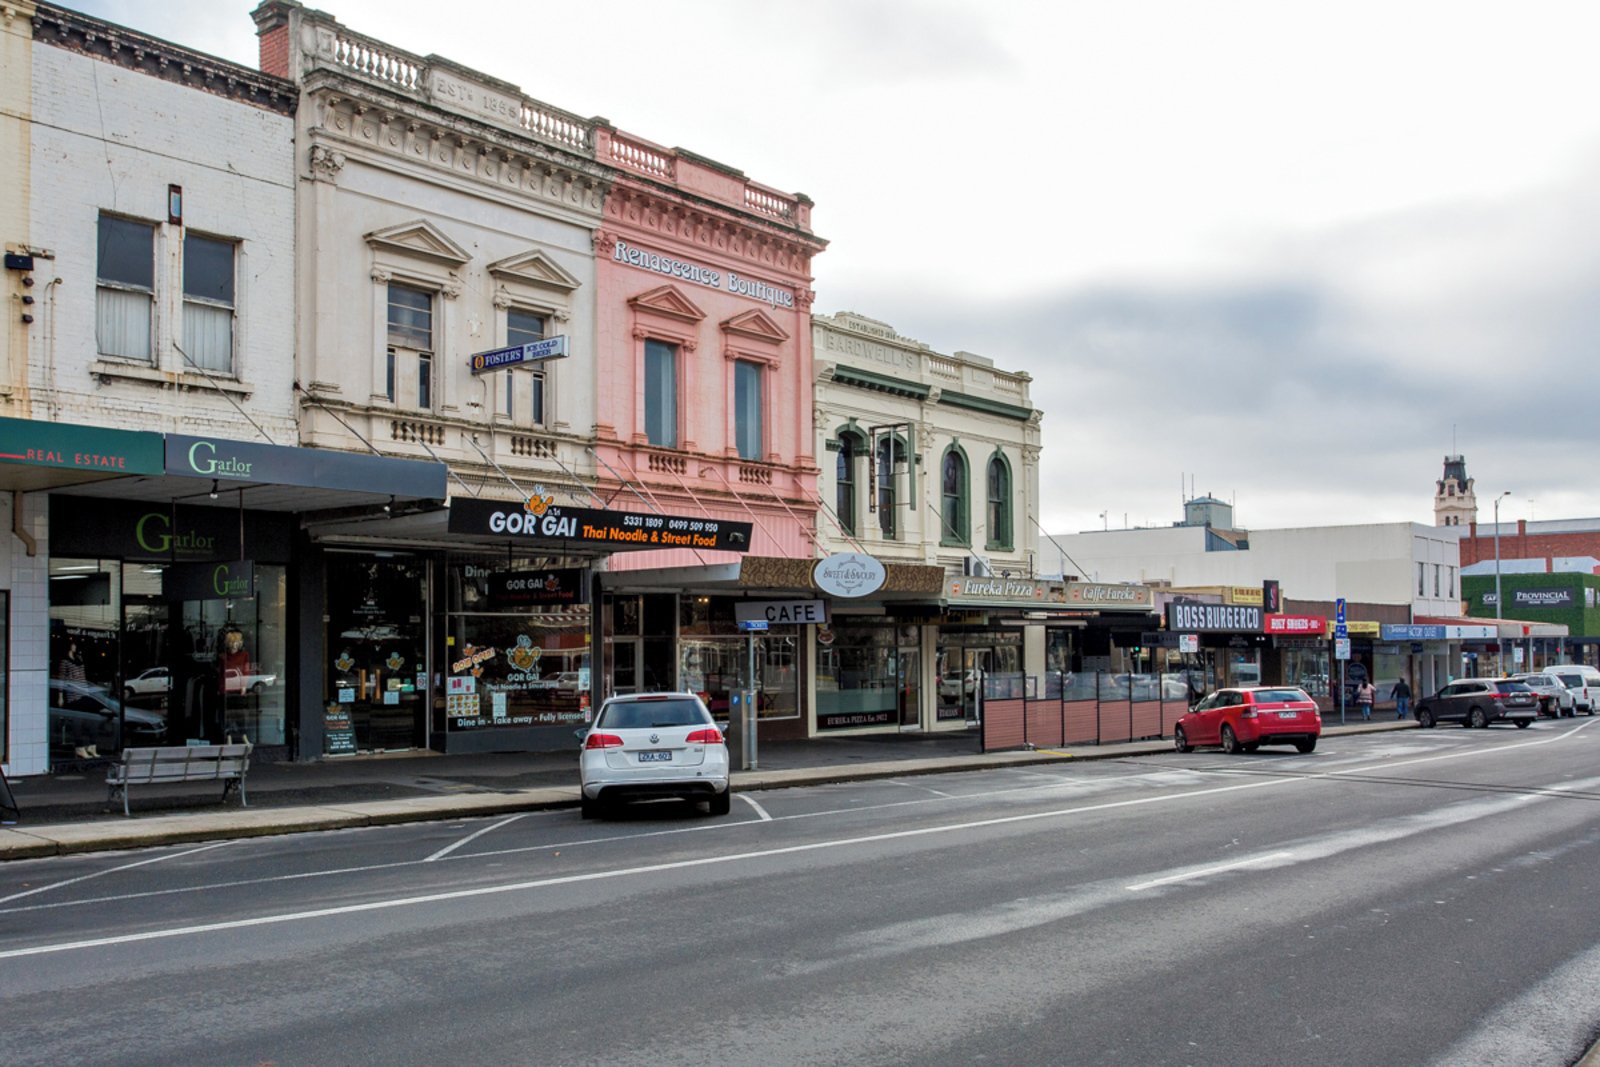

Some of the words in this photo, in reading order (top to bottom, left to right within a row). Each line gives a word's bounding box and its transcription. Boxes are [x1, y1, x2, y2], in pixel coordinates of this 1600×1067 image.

[614, 240, 721, 288] Renascence
[727, 272, 793, 309] Boutique
[526, 344, 538, 352] ICE
[538, 340, 558, 349] COLD
[532, 348, 552, 358] BEER
[26, 449, 64, 463] REAL
[75, 453, 126, 468] ESTATE
[188, 441, 253, 474] Garlor
[489, 511, 536, 535] GOR
[541, 516, 578, 537] GAI
[623, 516, 644, 527] 5331
[645, 517, 663, 528] 1809
[668, 519, 688, 530] 0499
[688, 521, 703, 531] 509
[704, 522, 719, 533] 950
[582, 525, 607, 539] Thai
[609, 528, 648, 543] Noodle
[650, 532, 659, 543] &
[661, 532, 691, 546] Street
[693, 535, 717, 547] Food
[213, 565, 249, 596] Garlor
[506, 579, 526, 590] GOR
[527, 578, 543, 589] GAI
[963, 579, 1003, 596] Eureka
[1004, 581, 1033, 597] Pizza
[1106, 587, 1135, 600] Eureka
[1516, 590, 1568, 600] PROVINCIAL
[764, 604, 816, 622] CAFE
[507, 673, 525, 681] GOR
[525, 672, 540, 681] GAI
[457, 718, 475, 727] Dine
[478, 717, 485, 726] in
[493, 716, 512, 724] Take
[513, 715, 533, 724] away
[539, 713, 556, 723] Fully
[557, 711, 585, 721] licensed
